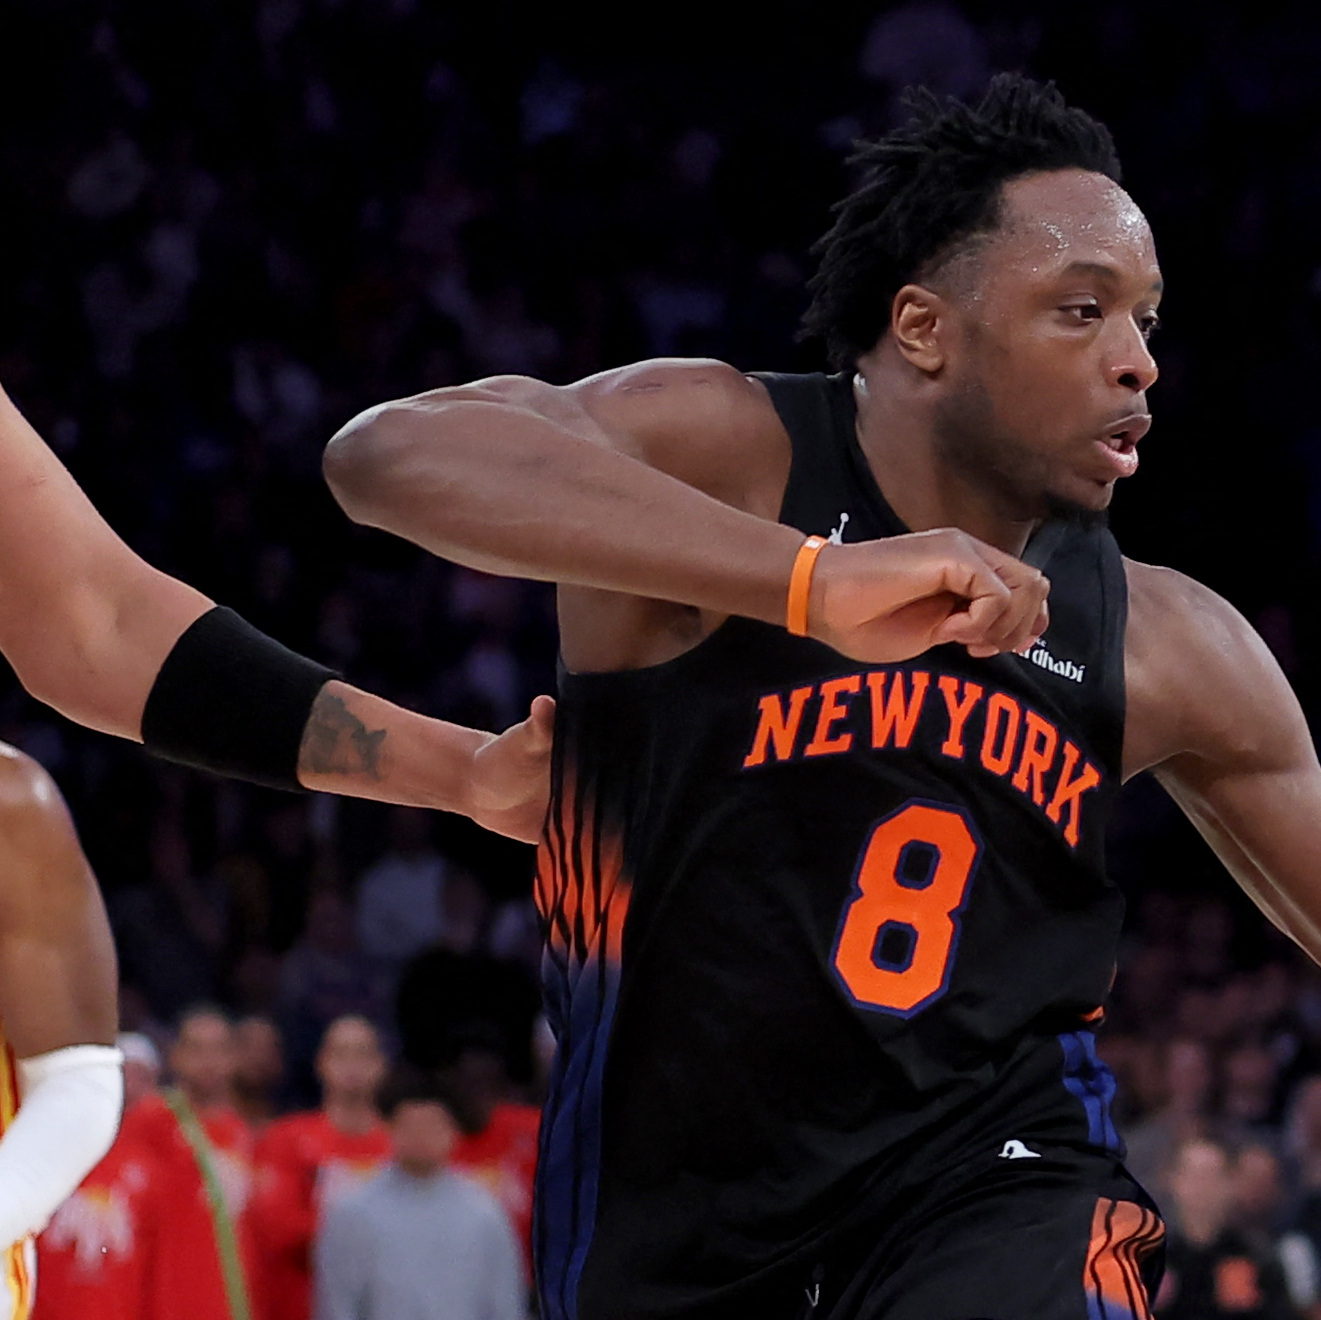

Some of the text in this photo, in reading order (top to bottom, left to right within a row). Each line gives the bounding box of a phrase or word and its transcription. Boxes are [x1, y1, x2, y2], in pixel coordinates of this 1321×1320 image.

[741, 670, 1102, 849] NEW YORK
[829, 797, 985, 1020] 8
